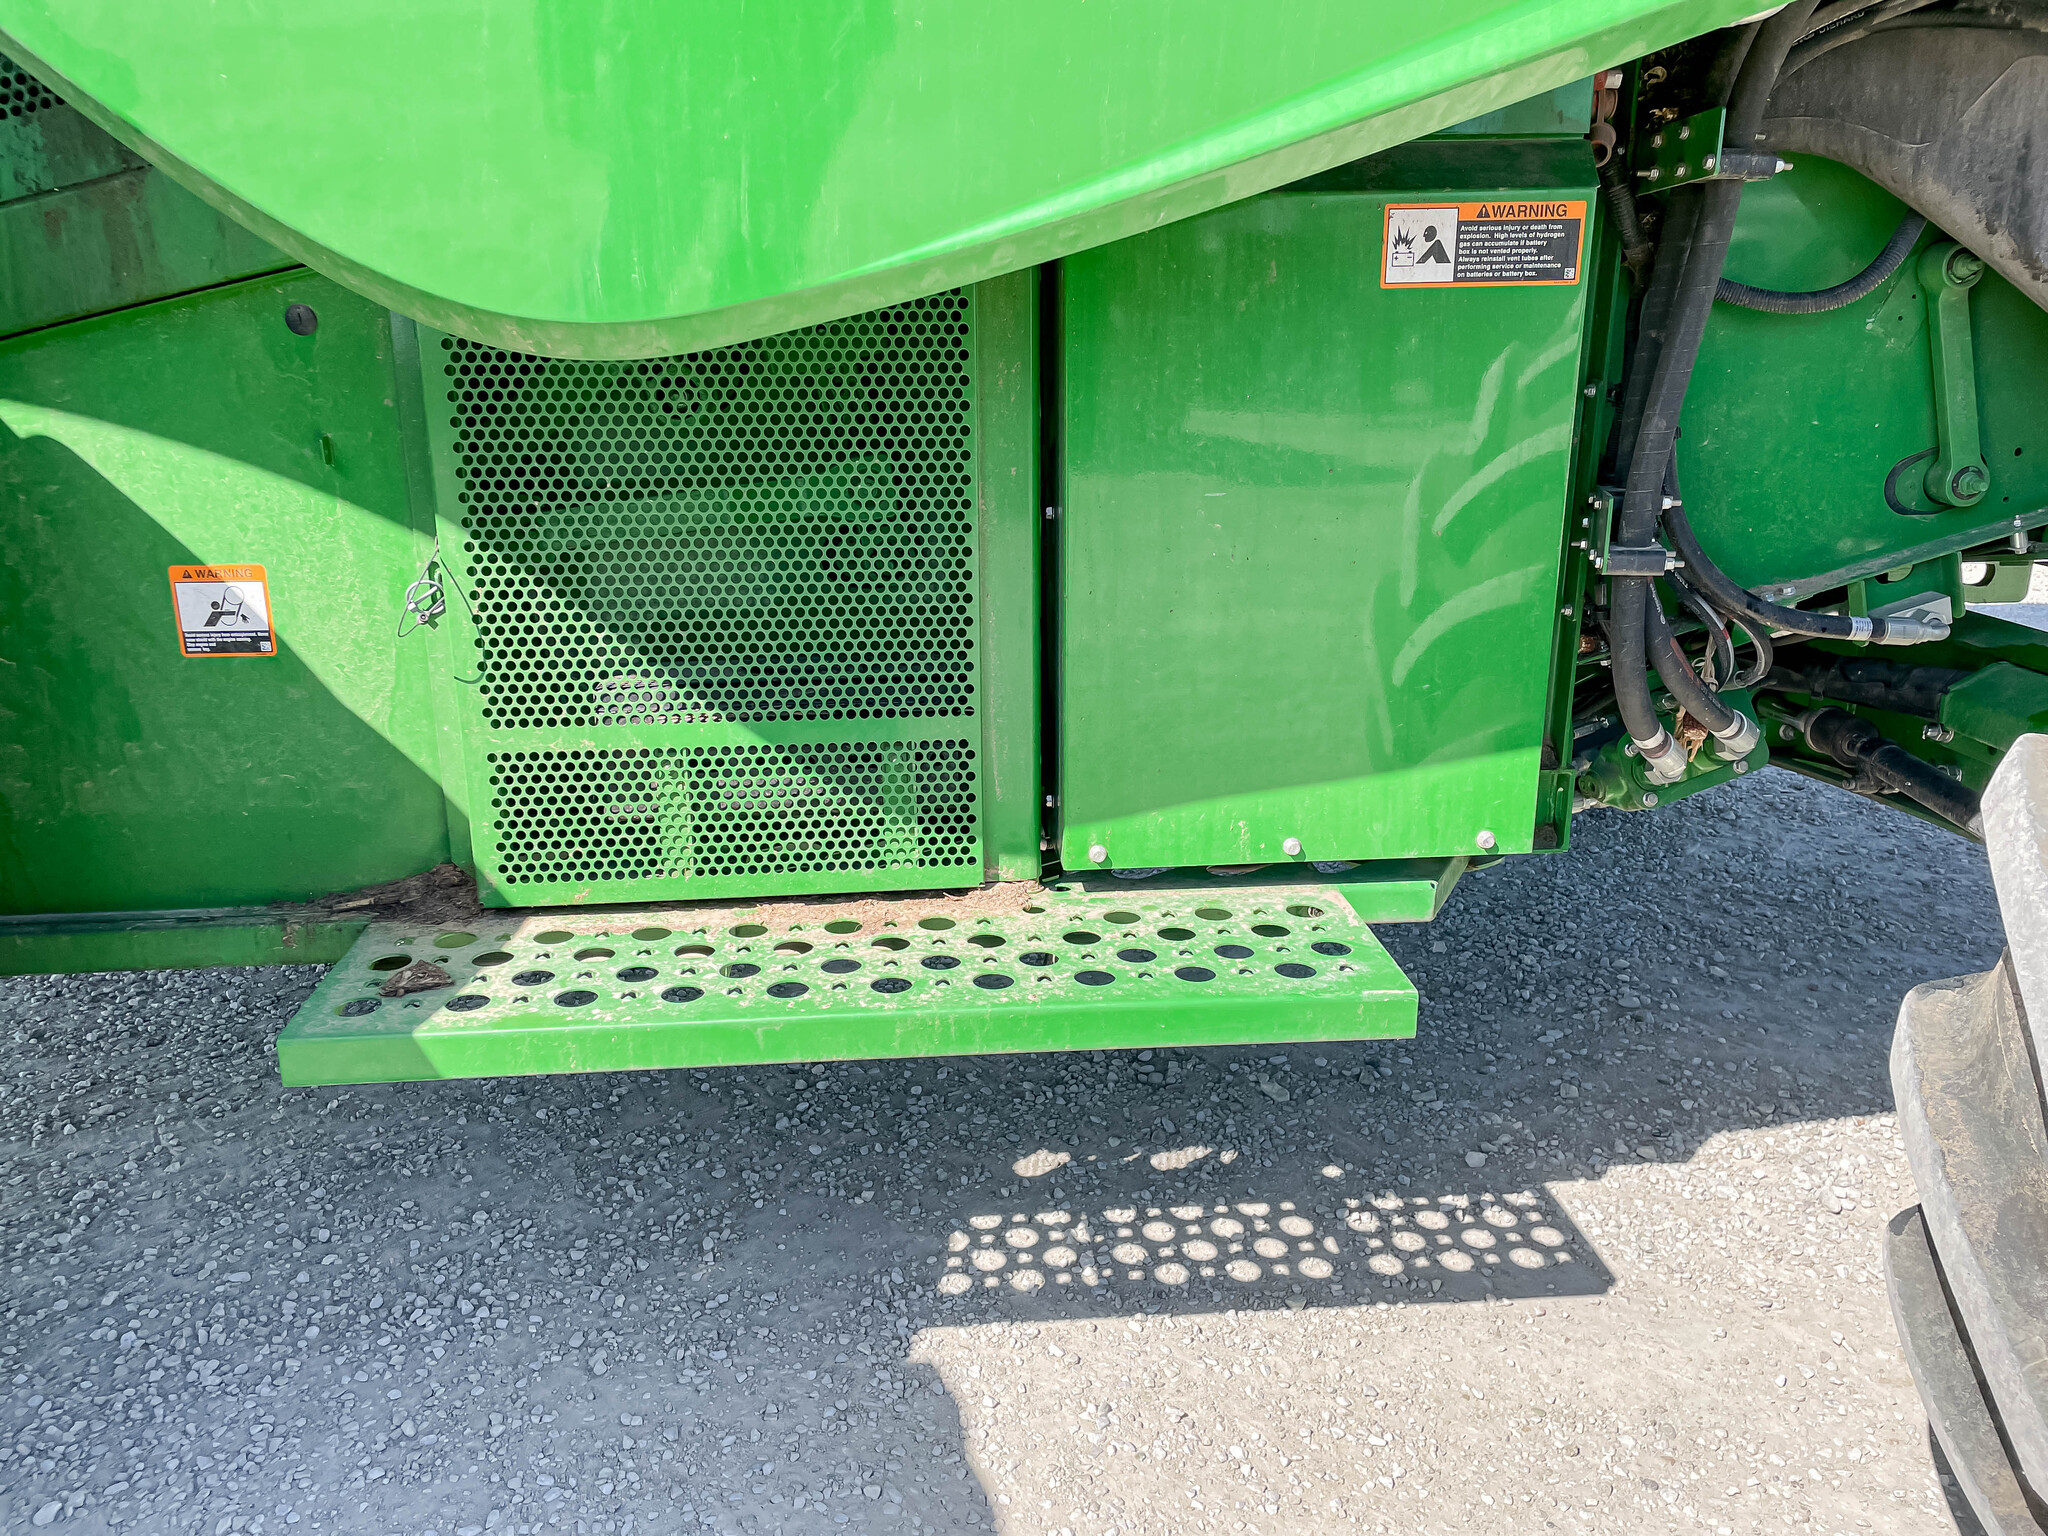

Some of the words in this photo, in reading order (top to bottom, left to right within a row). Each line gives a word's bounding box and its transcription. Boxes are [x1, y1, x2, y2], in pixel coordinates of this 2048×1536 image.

[1492, 204, 1568, 218] WARNING
[1502, 270, 1524, 278] battery
[194, 568, 253, 579] WARNING
